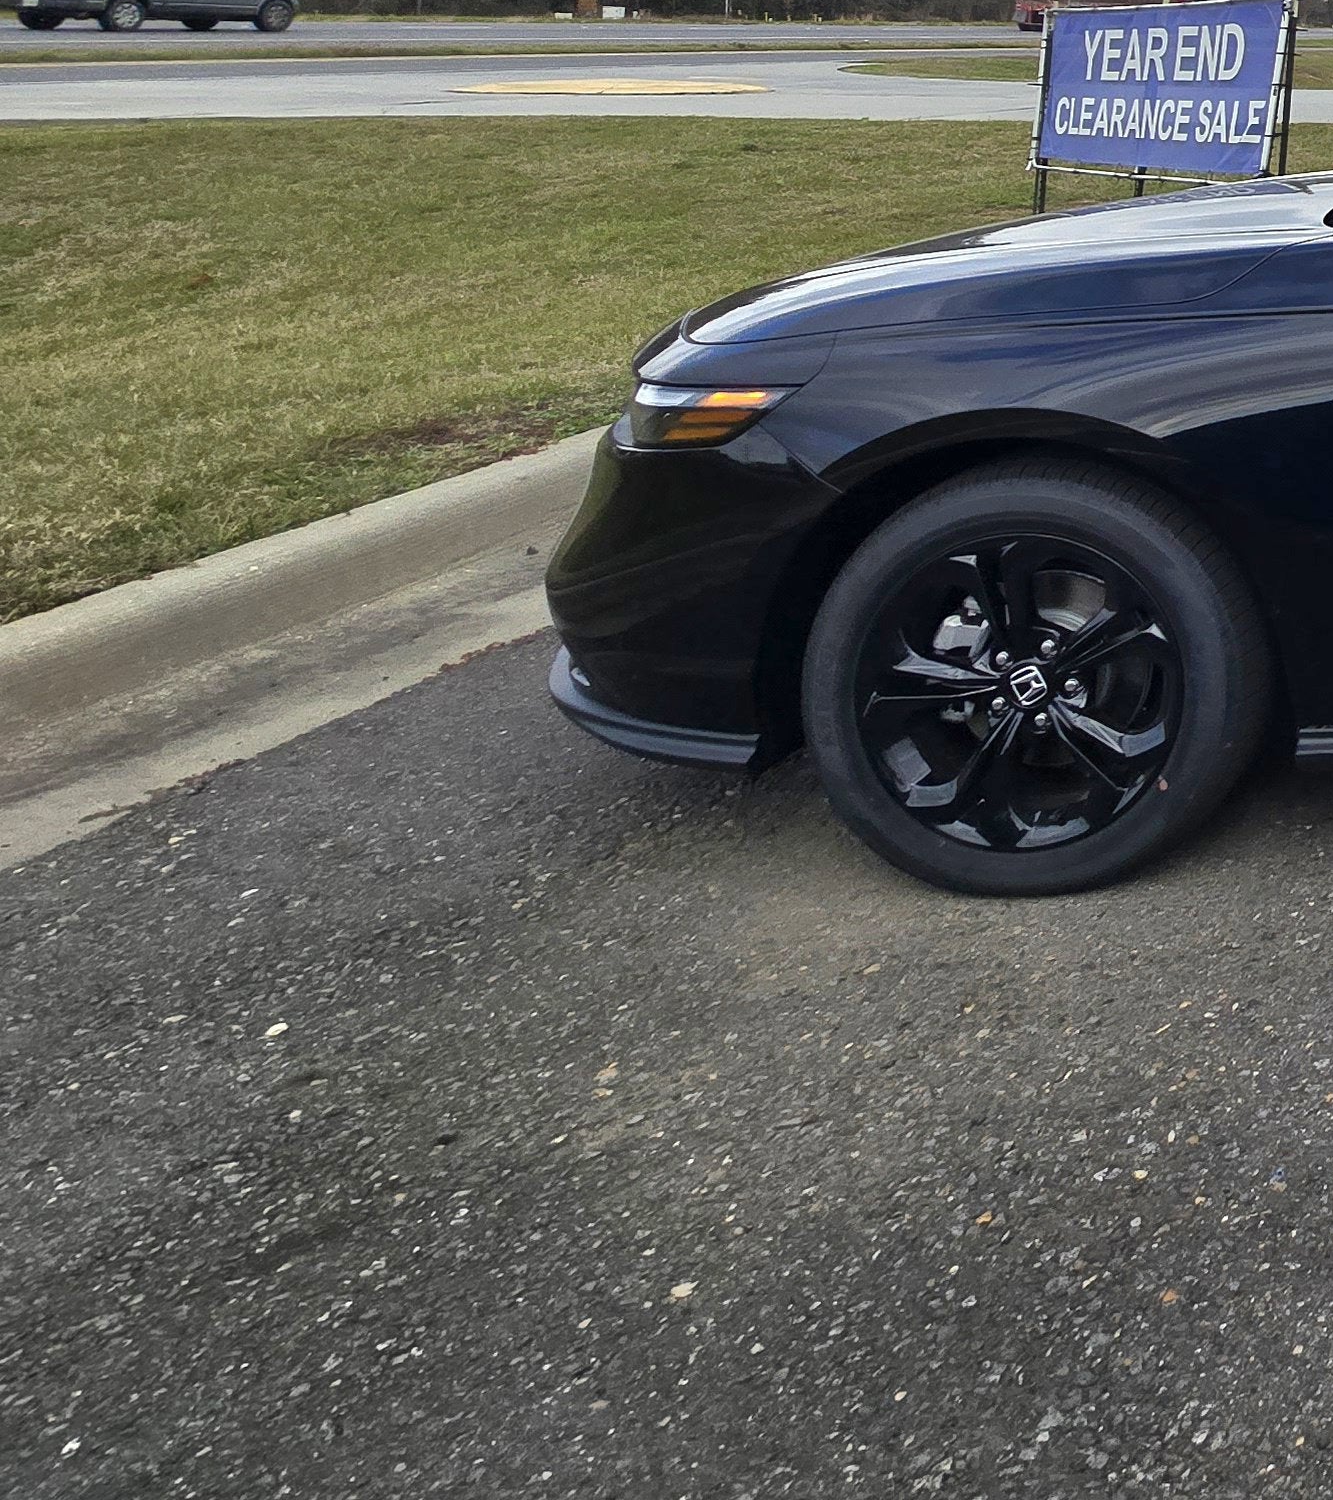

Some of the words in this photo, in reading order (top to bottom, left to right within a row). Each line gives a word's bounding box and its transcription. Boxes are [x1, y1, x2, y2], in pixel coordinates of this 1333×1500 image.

[1084, 27, 1168, 81] YEAR
[1173, 23, 1246, 82] END
[1054, 96, 1194, 141] CLEARANCE
[1195, 99, 1266, 144] SALE
